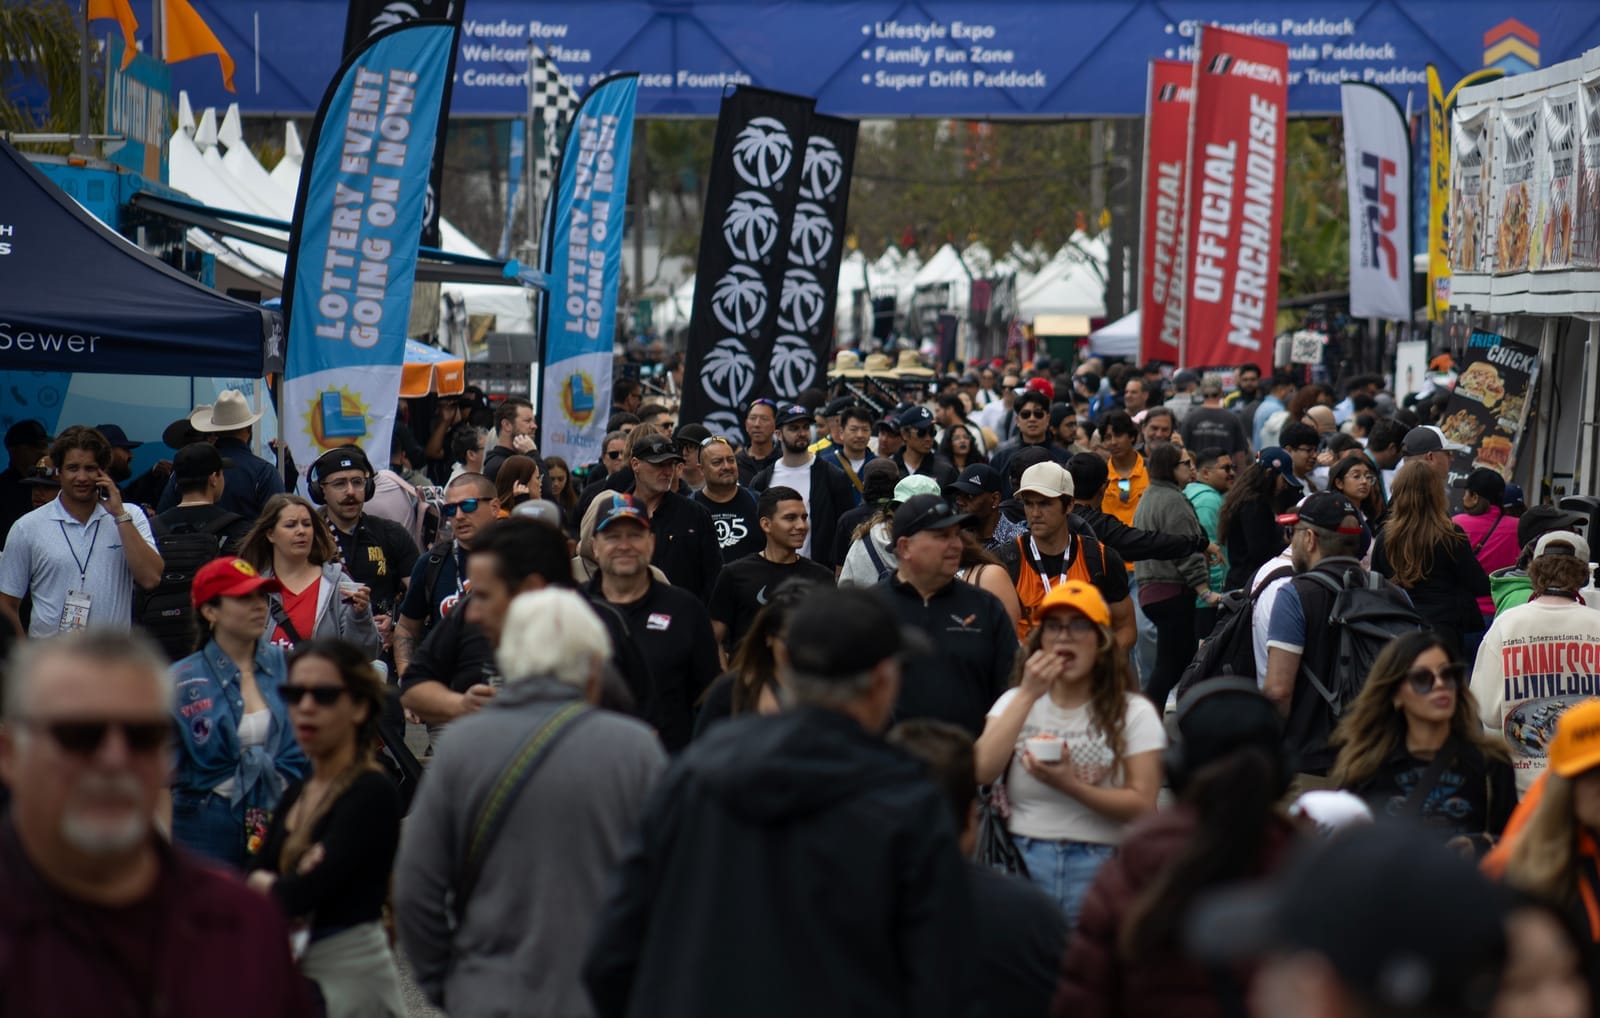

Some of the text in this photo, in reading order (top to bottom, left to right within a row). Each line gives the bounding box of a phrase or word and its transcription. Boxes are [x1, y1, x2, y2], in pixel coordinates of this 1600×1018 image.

[463, 20, 568, 38] Vendor Row
[875, 21, 996, 43] Lifestyle Expo
[1282, 18, 1354, 36] Paddock
[463, 44, 591, 62] Welcom Plaza
[875, 46, 1014, 67] Family Fun Zone
[1322, 42, 1395, 60] Paddock
[677, 70, 751, 88] Fountain
[875, 69, 1046, 91] Super Drift Paddock
[1305, 67, 1359, 84] Trucks
[1363, 66, 1427, 84] Paddoc
[315, 66, 384, 340] LOTTERY EVENT
[350, 69, 418, 348] GOING ON NOW!
[565, 113, 598, 333] LOTTERY EVENT
[591, 200, 610, 242] ON
[1152, 160, 1182, 304] OFFICIAL
[1193, 140, 1238, 304] OFFICIAL
[1227, 93, 1278, 351] MERCHANDISE
[585, 250, 606, 339] GOING
[0, 322, 100, 353] Sewer
[1469, 332, 1502, 348] FRIED
[1529, 633, 1583, 643] International
